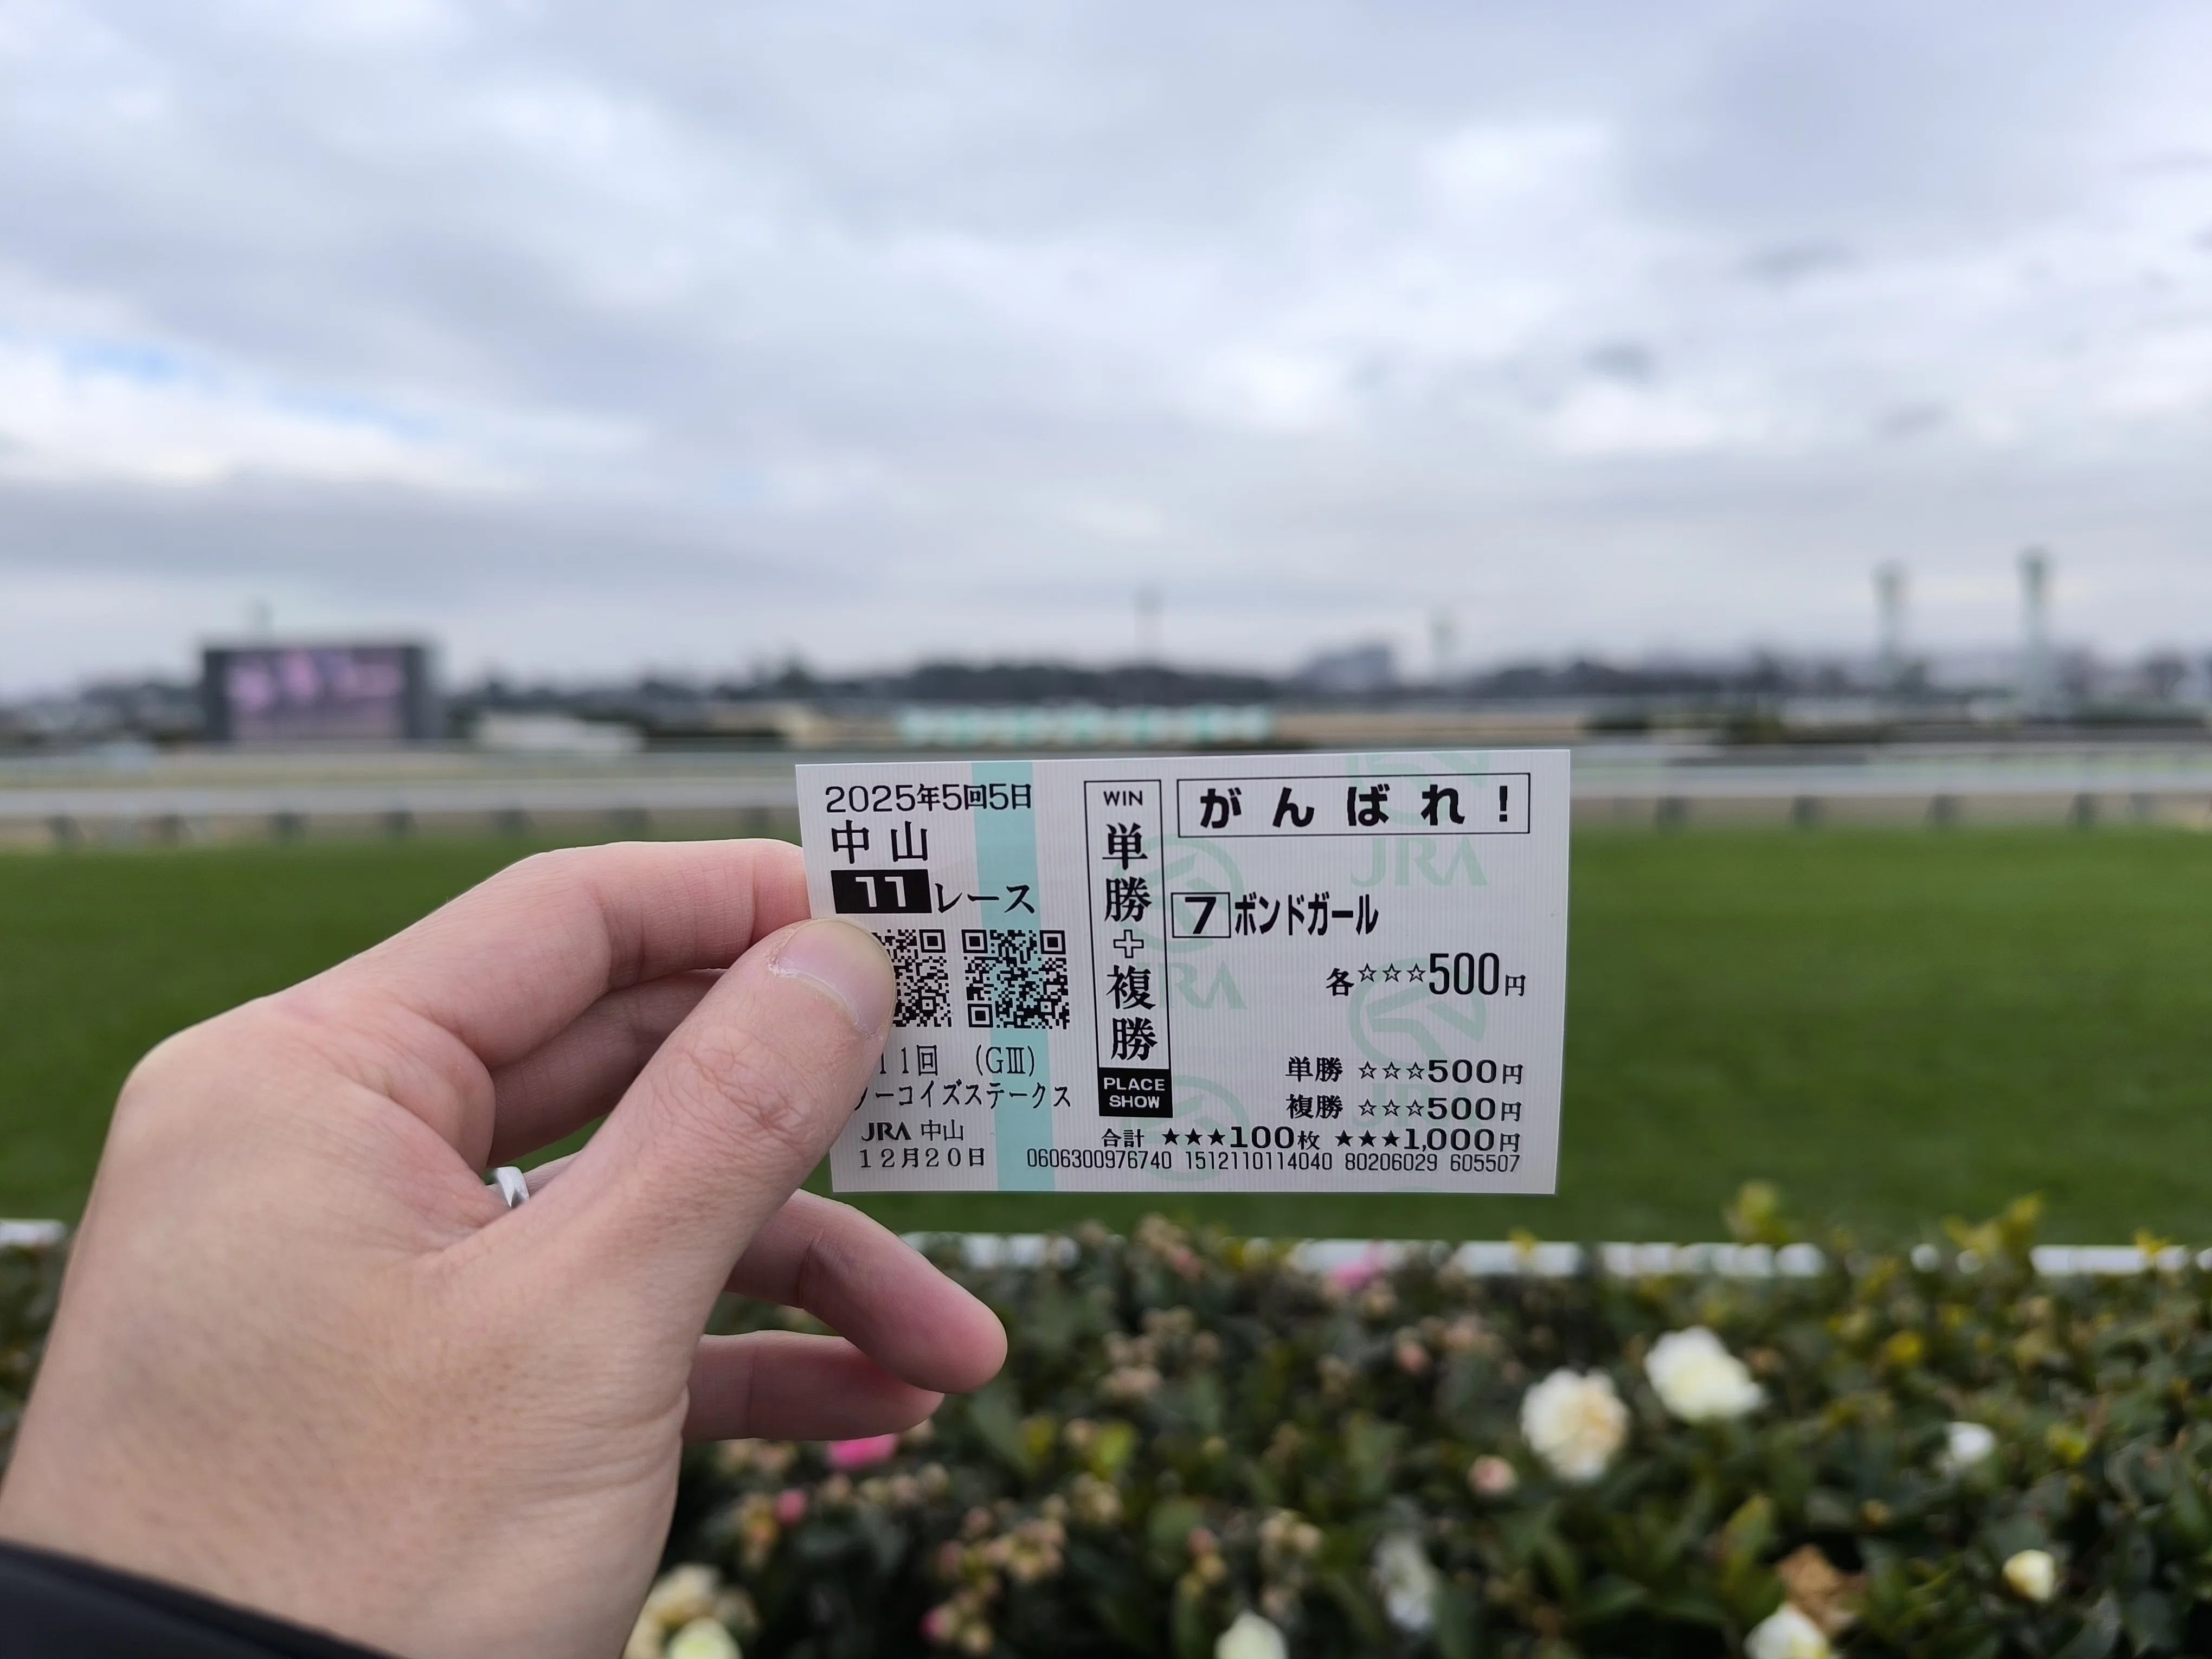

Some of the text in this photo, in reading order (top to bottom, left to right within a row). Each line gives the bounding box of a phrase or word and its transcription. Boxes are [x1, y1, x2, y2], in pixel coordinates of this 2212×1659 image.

[825, 783, 1032, 813] 2025年5回5日
[1103, 790, 1143, 806] WIN
[831, 819, 929, 864] 中山
[1351, 835, 1489, 888] JRA
[1185, 891, 1379, 936] 7 ボンドガール
[1285, 1056, 1343, 1083] 単勝
[1103, 1077, 1166, 1092] PLACE
[1109, 1095, 1160, 1109] SHOW
[1285, 1093, 1343, 1120] 複勝
[861, 1118, 964, 1142] JRA 中山
[1101, 1128, 1145, 1148] 合計
[859, 1147, 985, 1168] 12月20日
[1027, 1148, 1520, 1172] 0606300976740 1512110114040 80206029 605507
